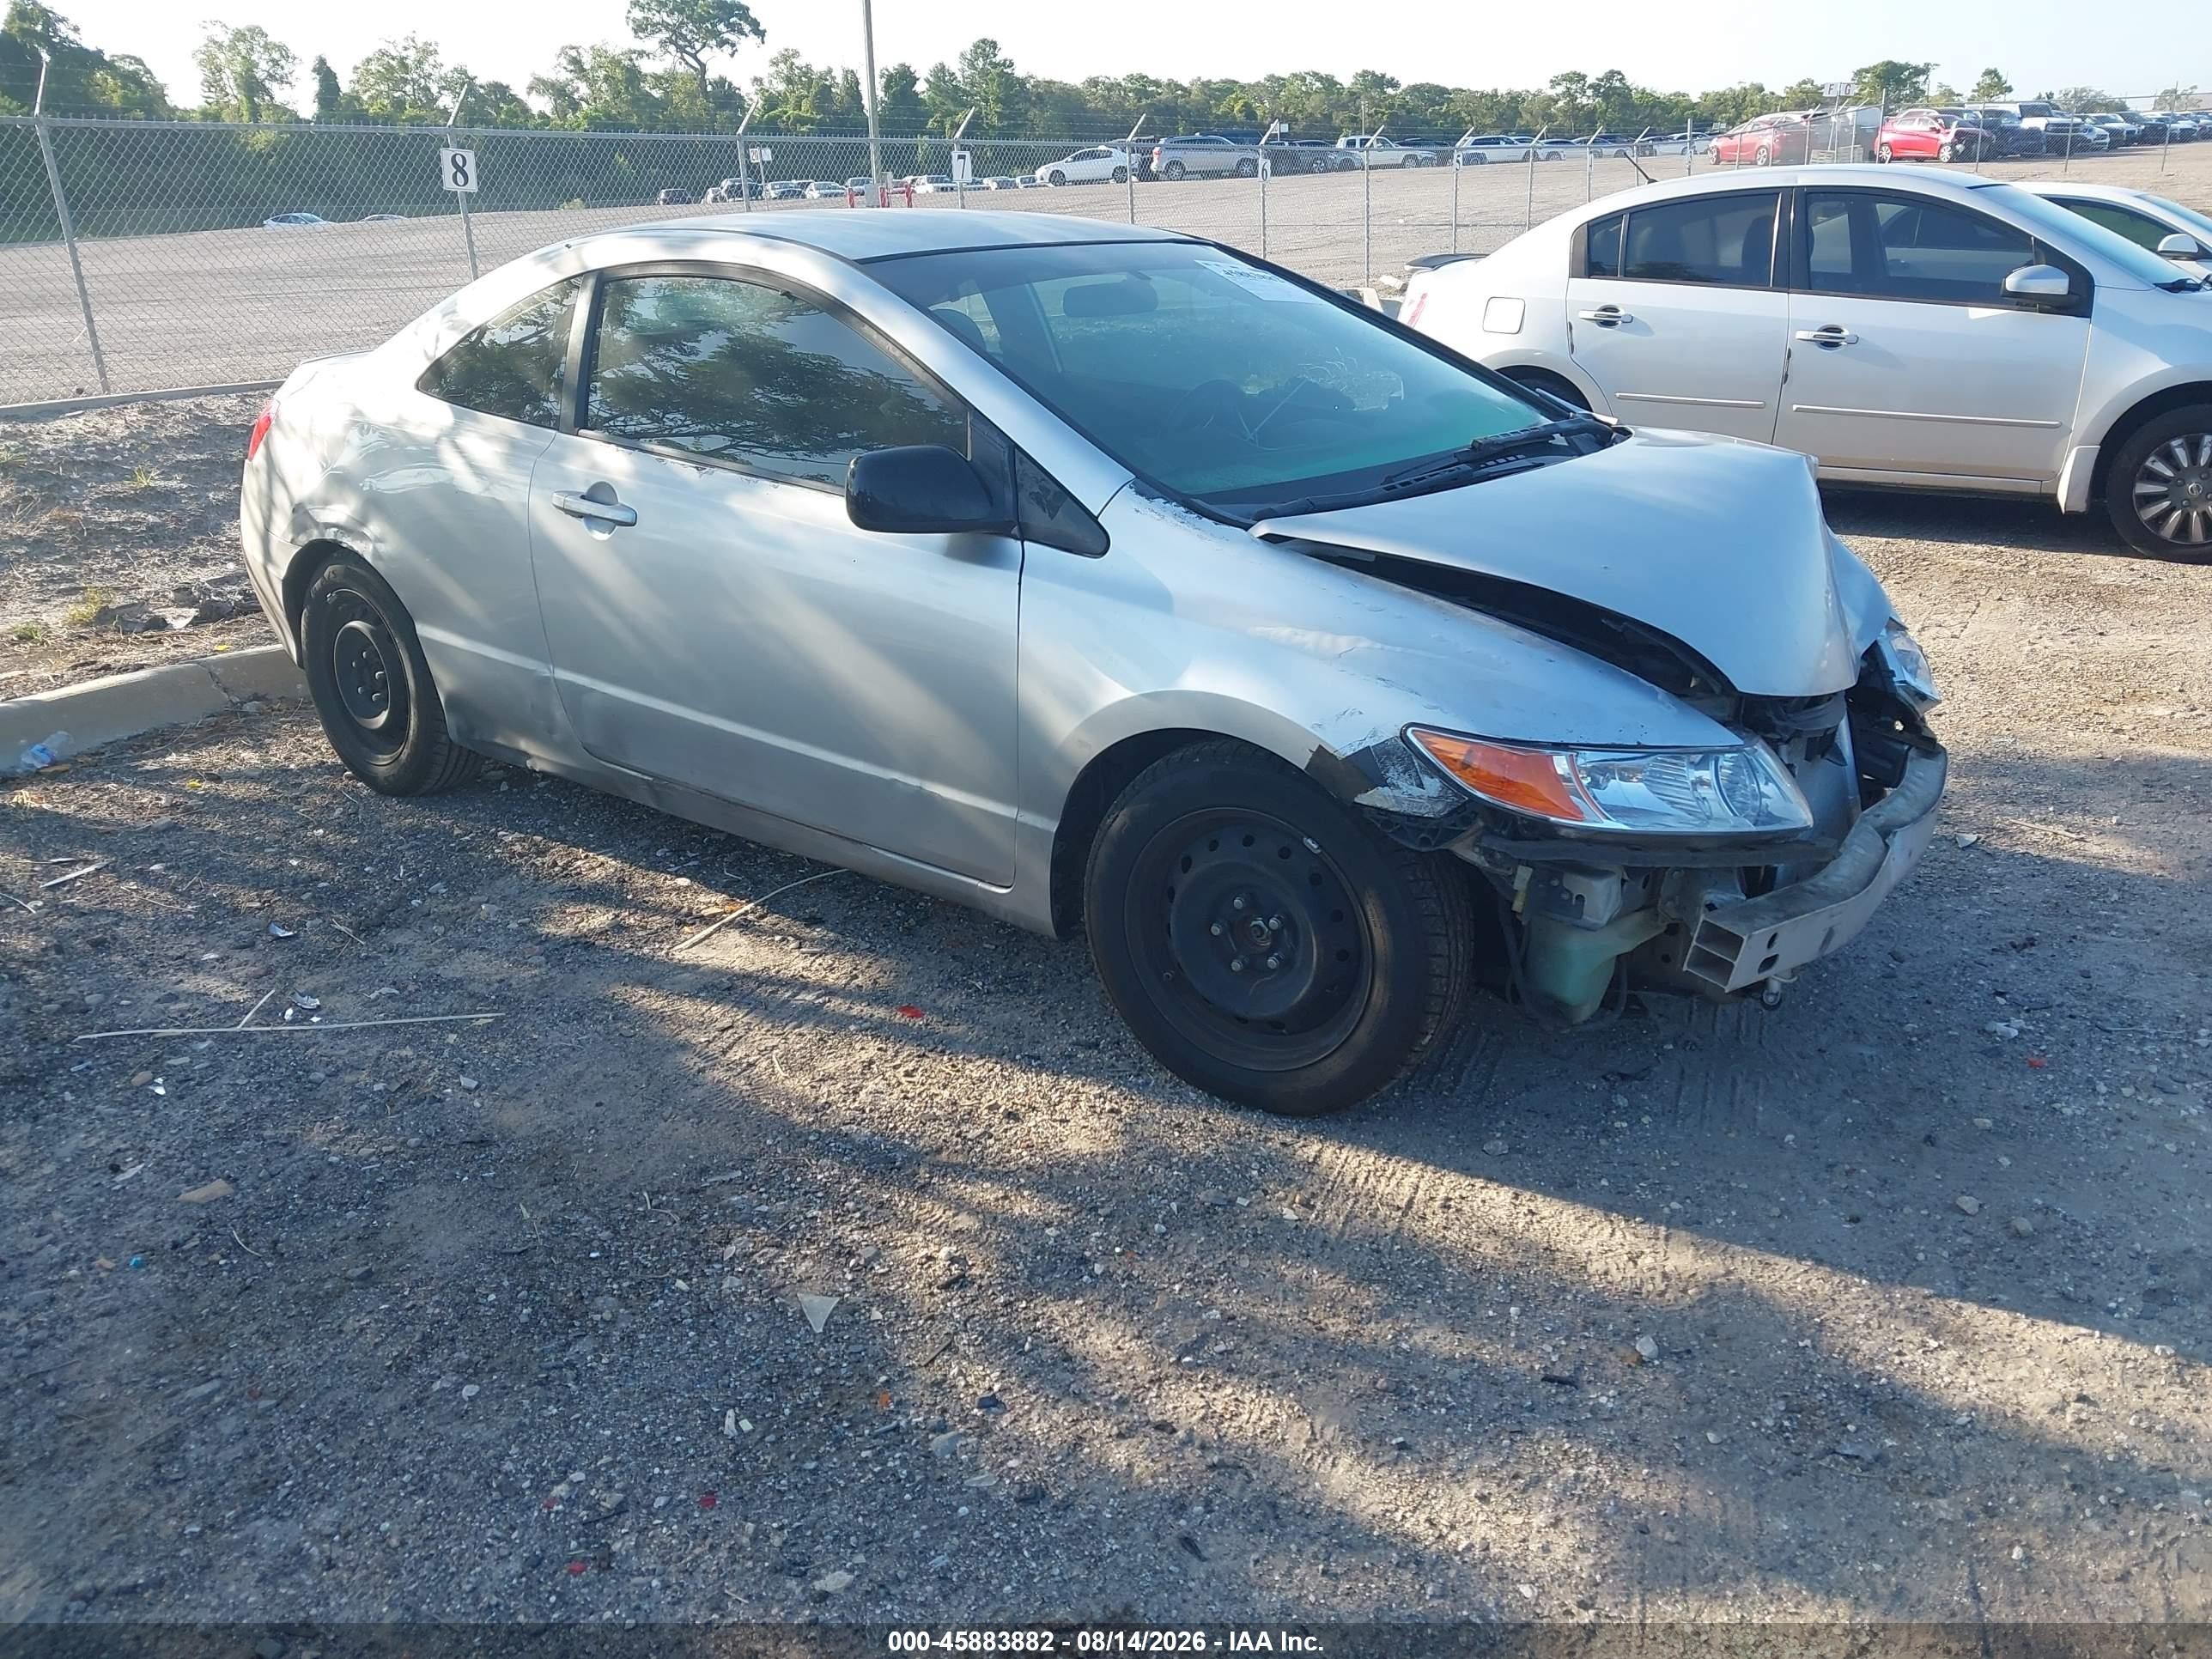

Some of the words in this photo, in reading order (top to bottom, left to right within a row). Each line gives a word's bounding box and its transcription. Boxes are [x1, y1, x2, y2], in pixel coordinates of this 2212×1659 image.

[1828, 83, 1835, 95] F
[1844, 83, 1851, 95] G
[450, 153, 470, 187] 8
[957, 154, 966, 179] 7
[1261, 161, 1268, 182] 6
[1455, 154, 1462, 171] 5
